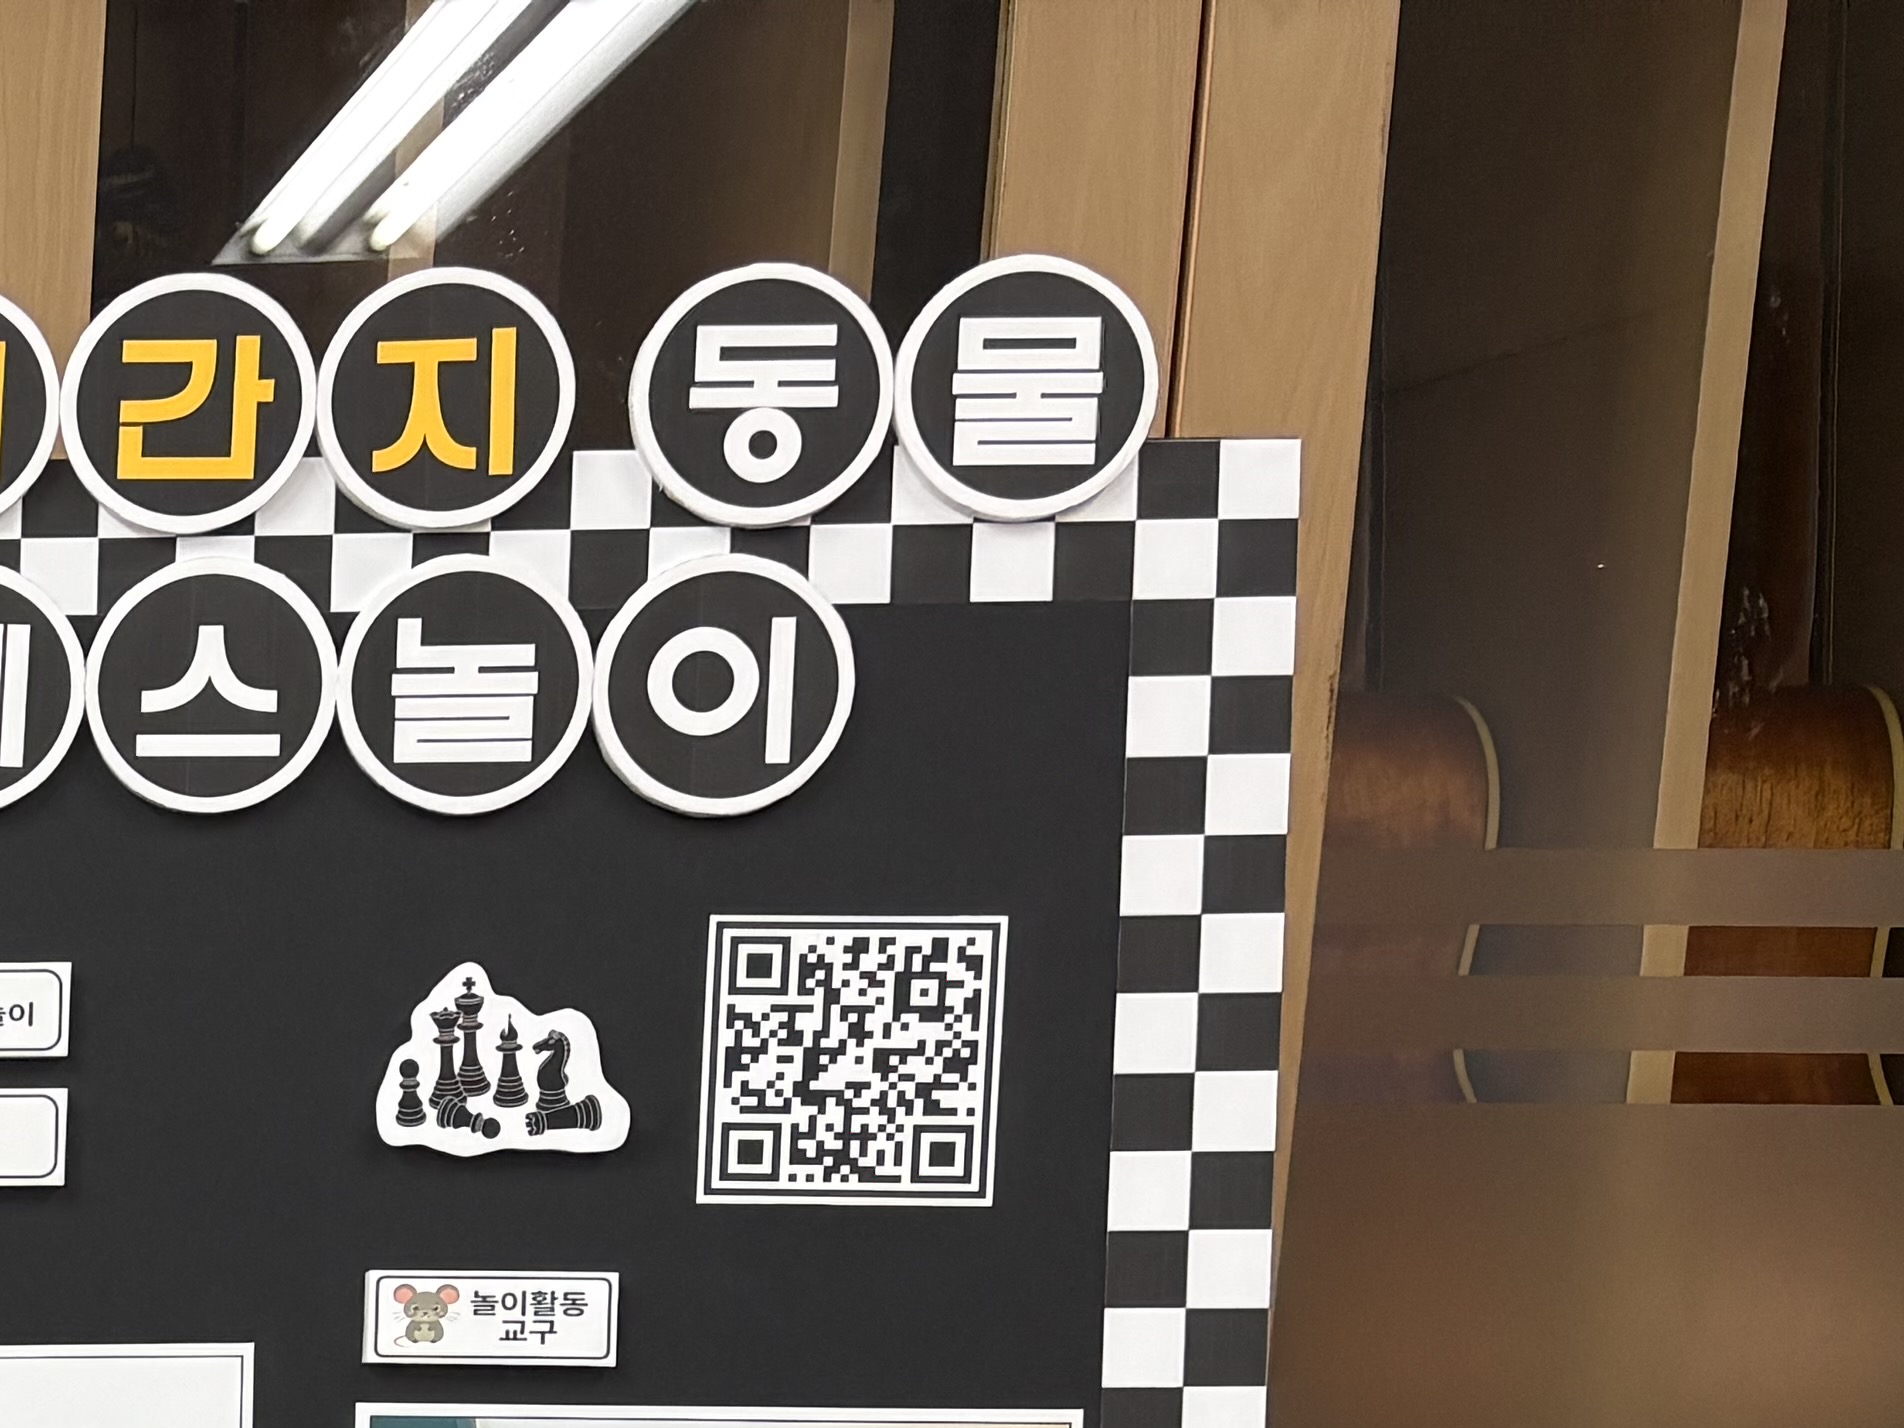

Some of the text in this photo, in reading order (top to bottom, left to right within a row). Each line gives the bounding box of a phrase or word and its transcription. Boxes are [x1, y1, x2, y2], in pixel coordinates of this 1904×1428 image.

[689, 318, 1108, 484] 동물
[470, 1290, 589, 1317] 놀이활동
[498, 1319, 558, 1345] 교구
